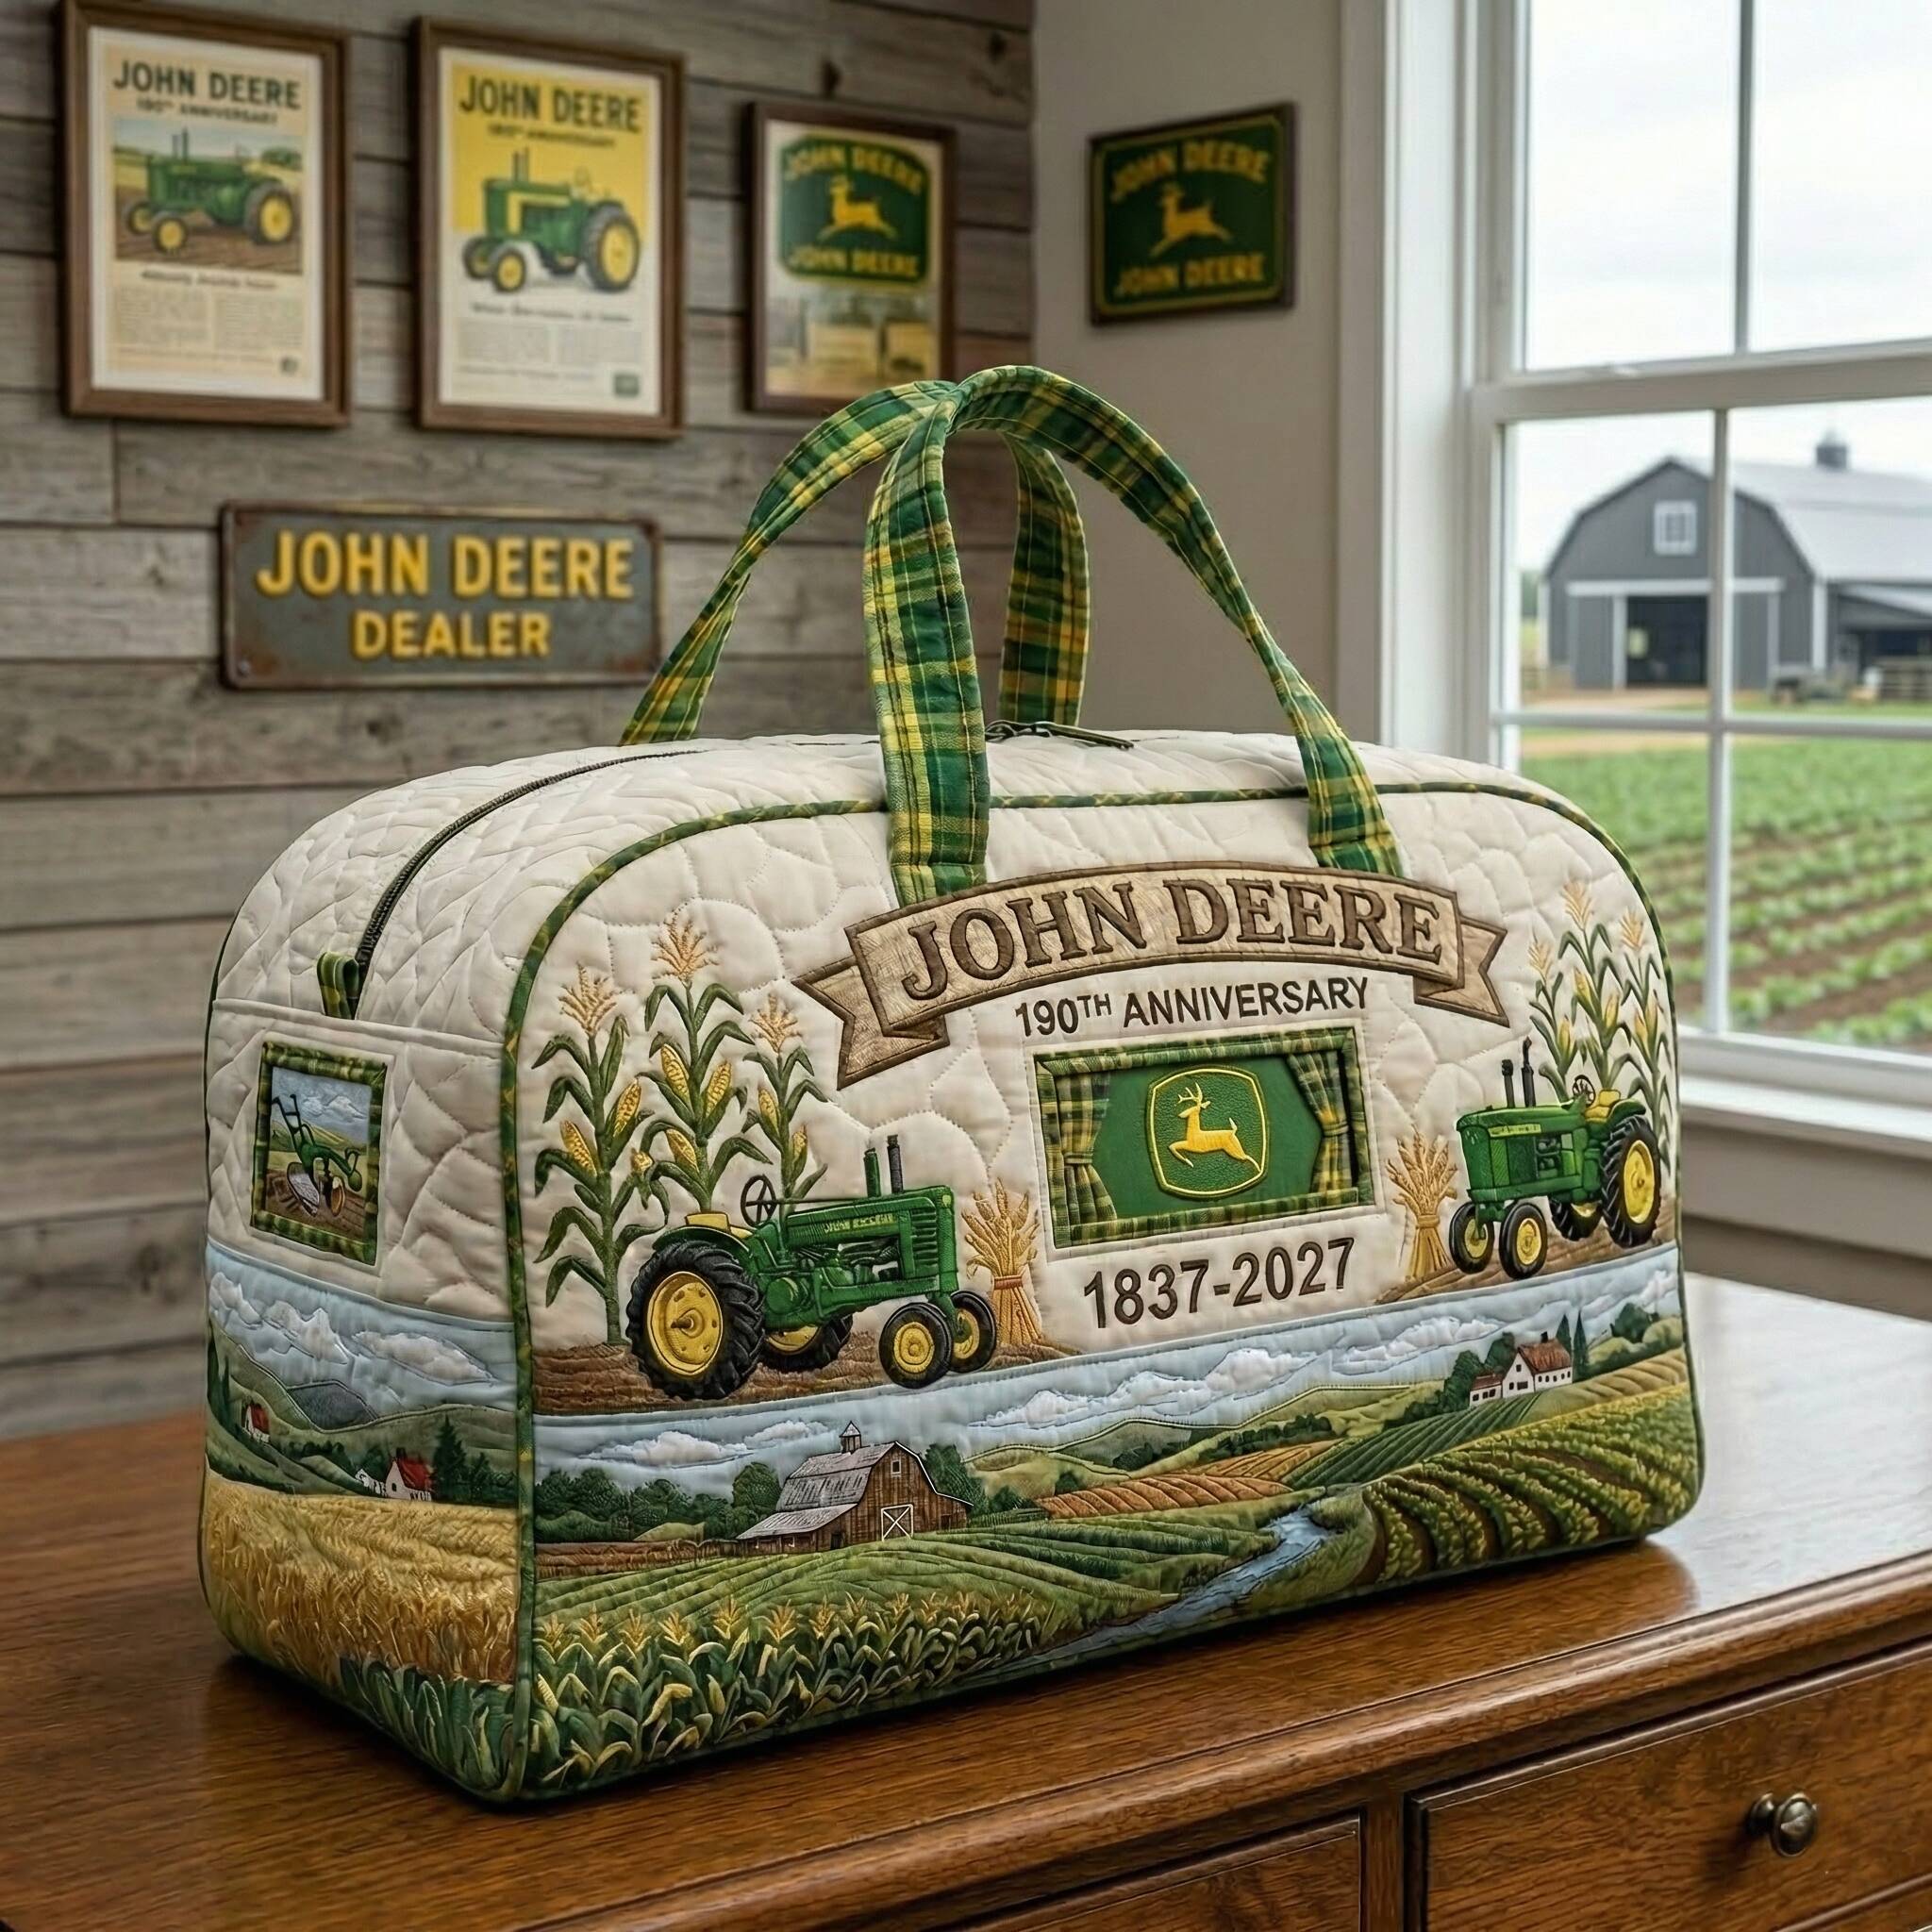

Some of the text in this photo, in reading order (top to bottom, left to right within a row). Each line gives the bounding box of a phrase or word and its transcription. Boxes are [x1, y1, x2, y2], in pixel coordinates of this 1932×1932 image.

[112, 60, 302, 110] JOHN DEERE
[459, 75, 642, 134] JOHN DEERE
[851, 144, 924, 196] DEERE
[1110, 141, 1270, 204] JOHN DEERE
[851, 248, 920, 277] DEERE
[1113, 252, 1265, 297] JOHN DEERE
[256, 529, 636, 600] JOHN DEERE
[353, 608, 552, 659] DEALER
[901, 876, 1444, 1001] JOHN DEERE
[1014, 975, 1370, 1038] 190TH ANNIVERSARY
[1083, 1236, 1356, 1330] 1837-2027
